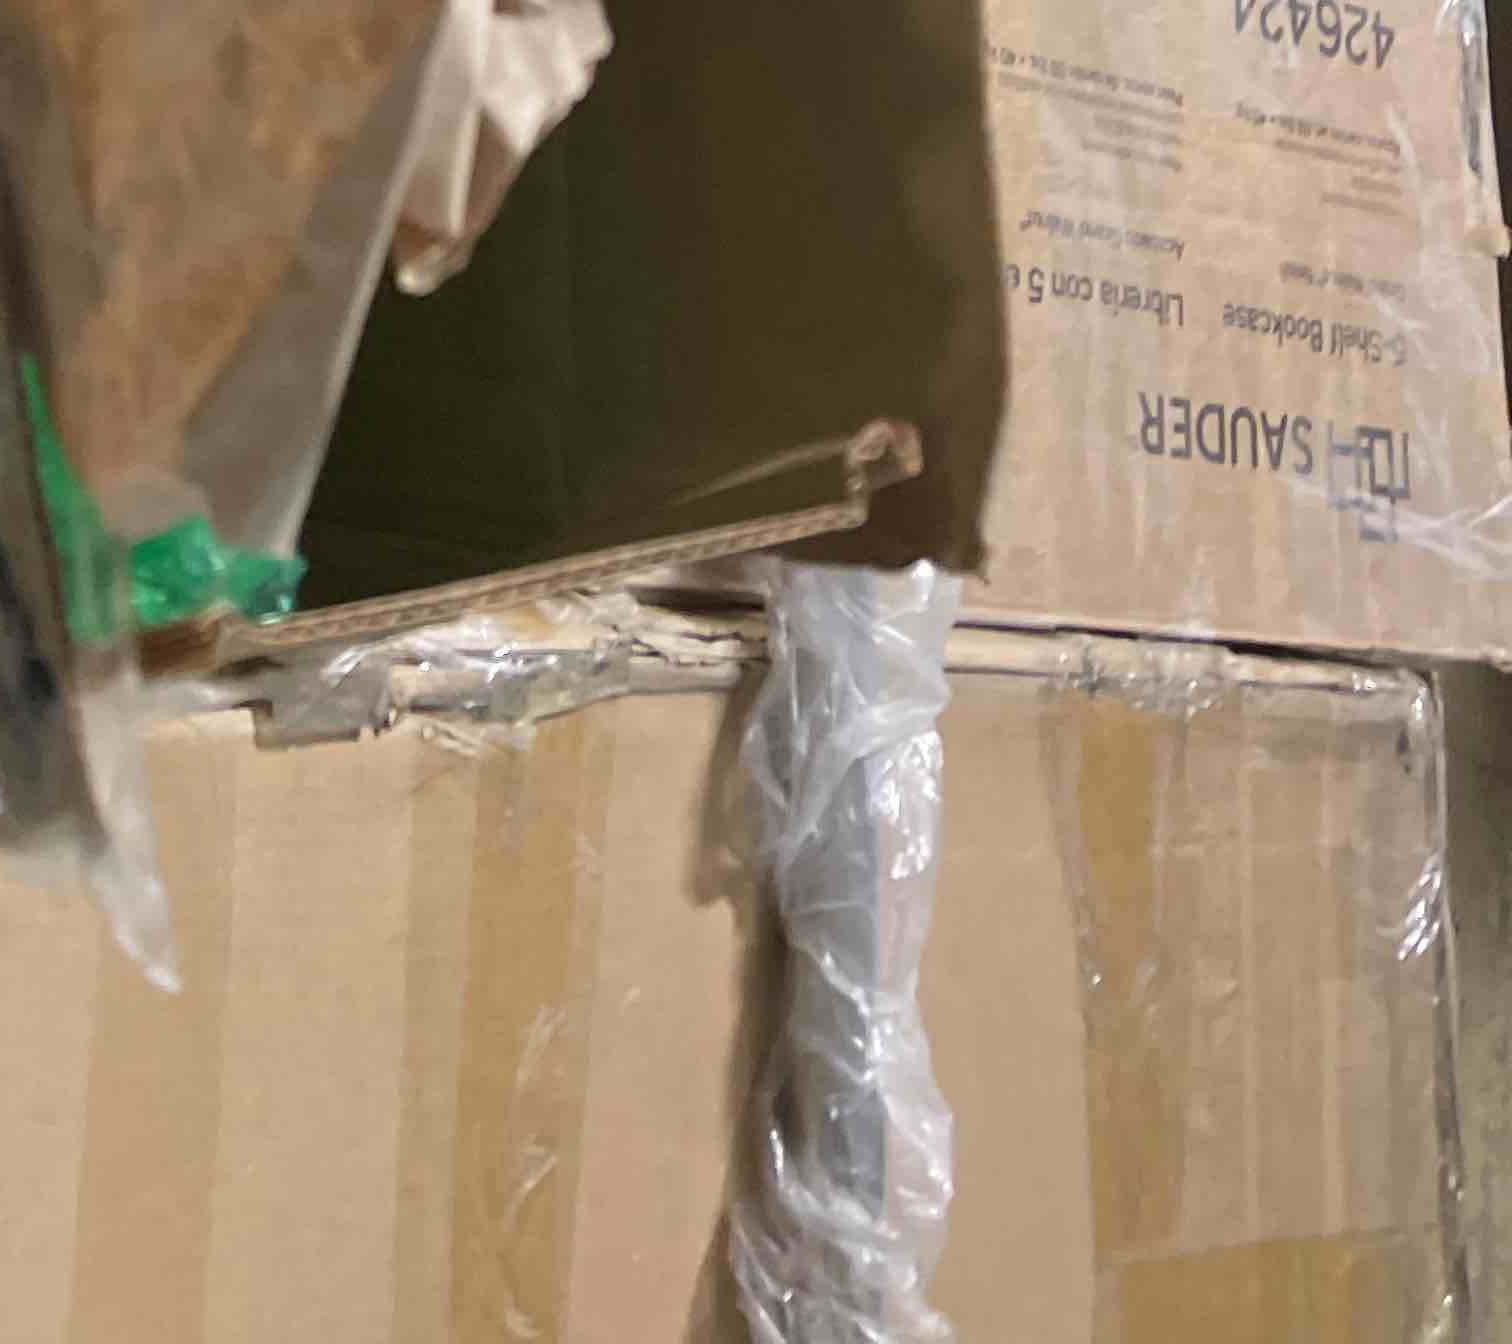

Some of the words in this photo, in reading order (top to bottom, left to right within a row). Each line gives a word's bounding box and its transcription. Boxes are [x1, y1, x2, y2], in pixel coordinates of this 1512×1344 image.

[1029, 267, 1043, 303] 5
[1053, 275, 1093, 300] con
[1223, 303, 1322, 353] Bookcase
[1138, 392, 1313, 475] SAUDER
